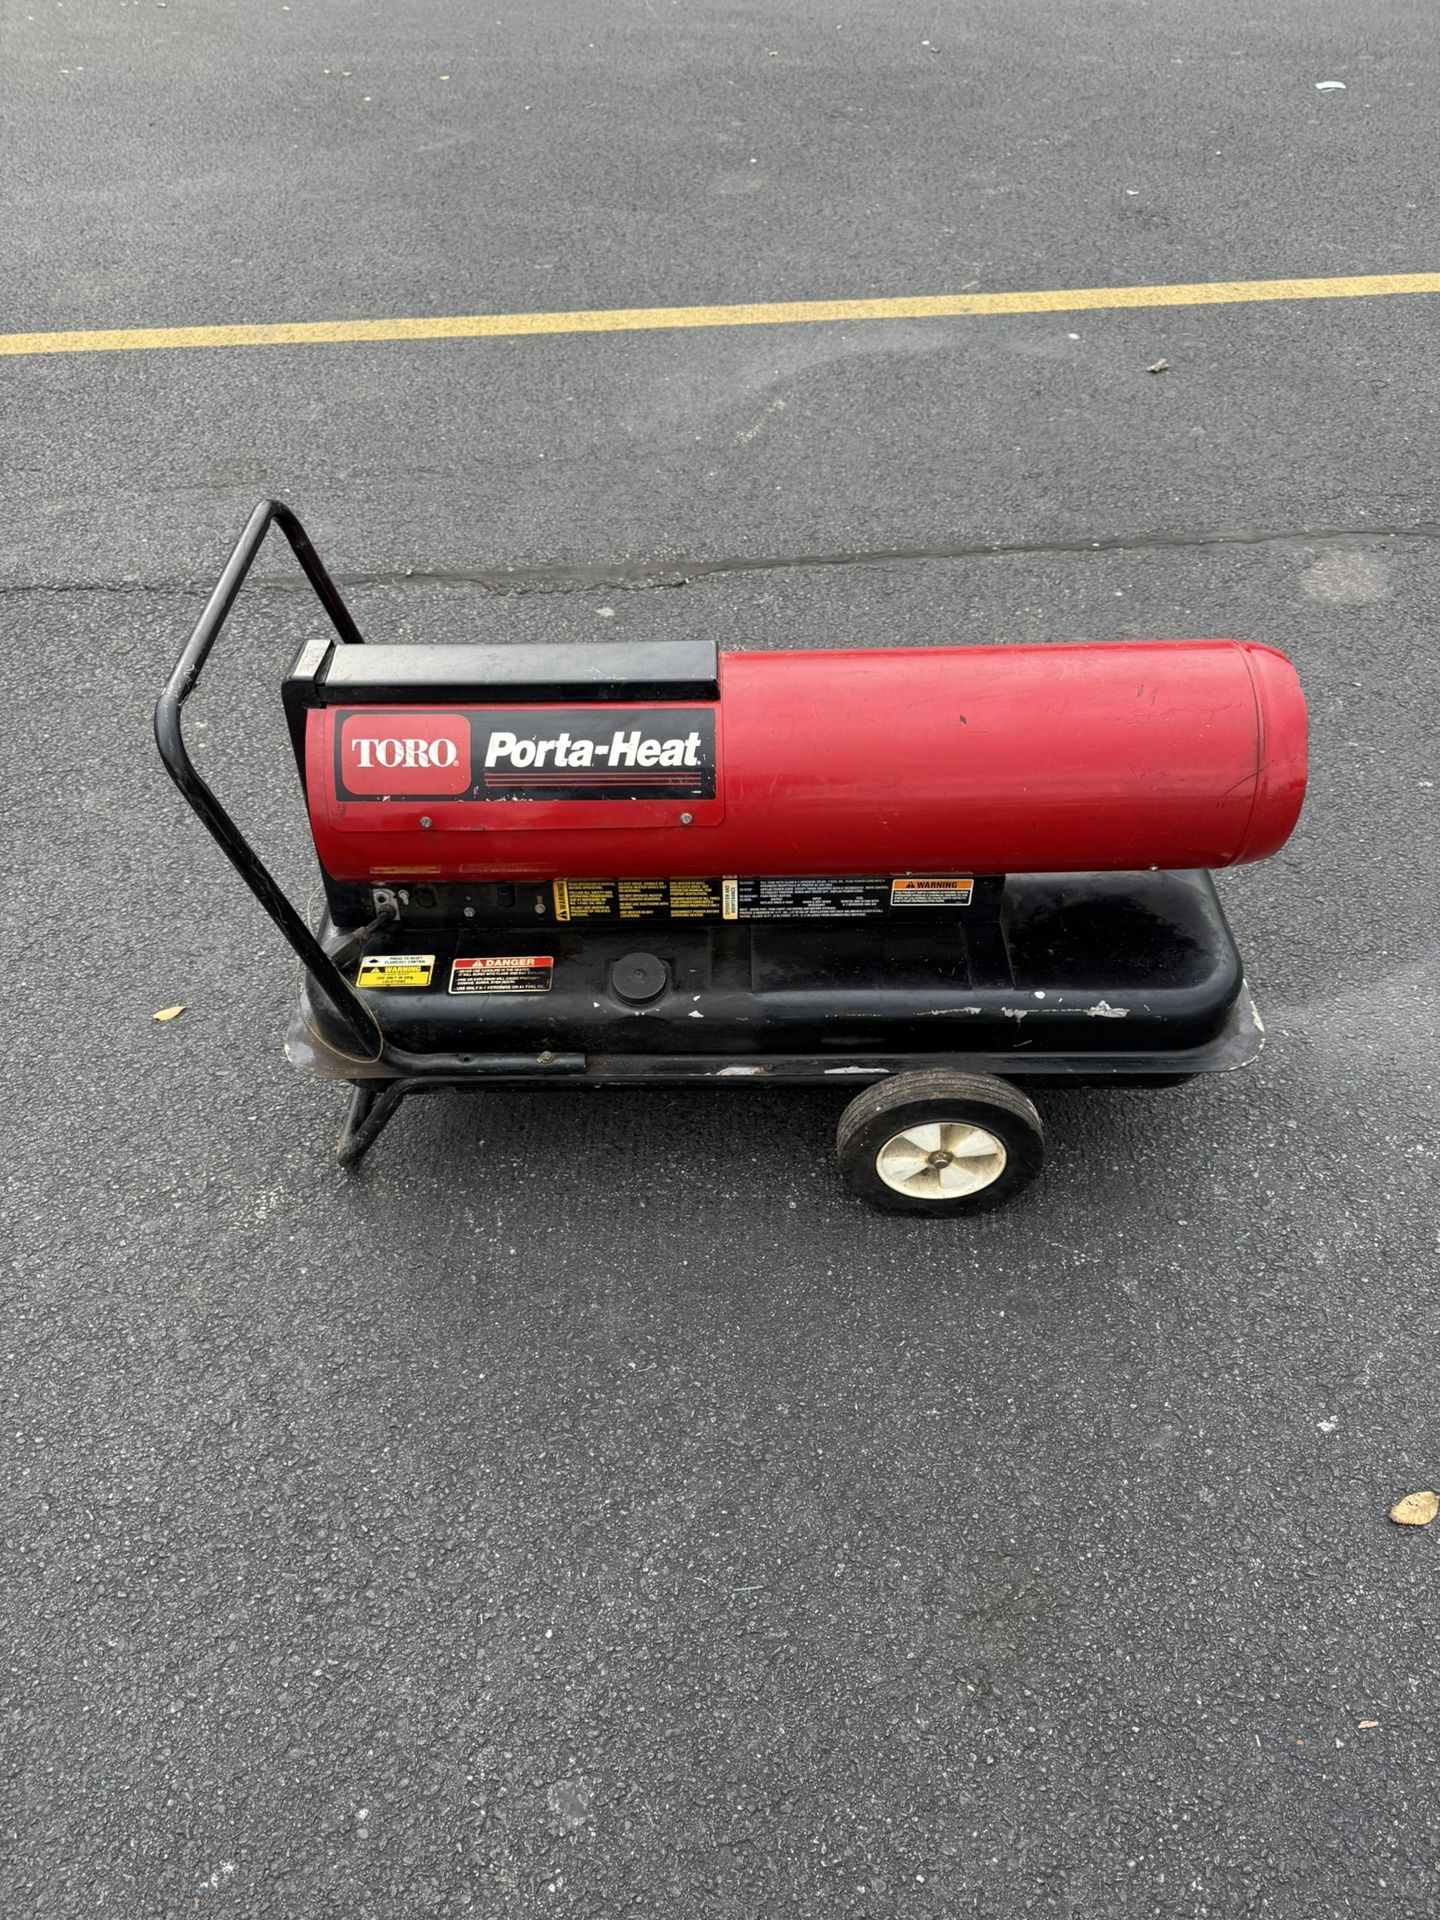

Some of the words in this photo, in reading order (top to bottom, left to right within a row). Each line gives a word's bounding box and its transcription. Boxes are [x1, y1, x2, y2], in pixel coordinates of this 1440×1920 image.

[484, 731, 702, 768] Porta-Heat
[916, 881, 958, 889] WARNING
[557, 883, 566, 910] WARNING
[486, 958, 535, 967] DANGER
